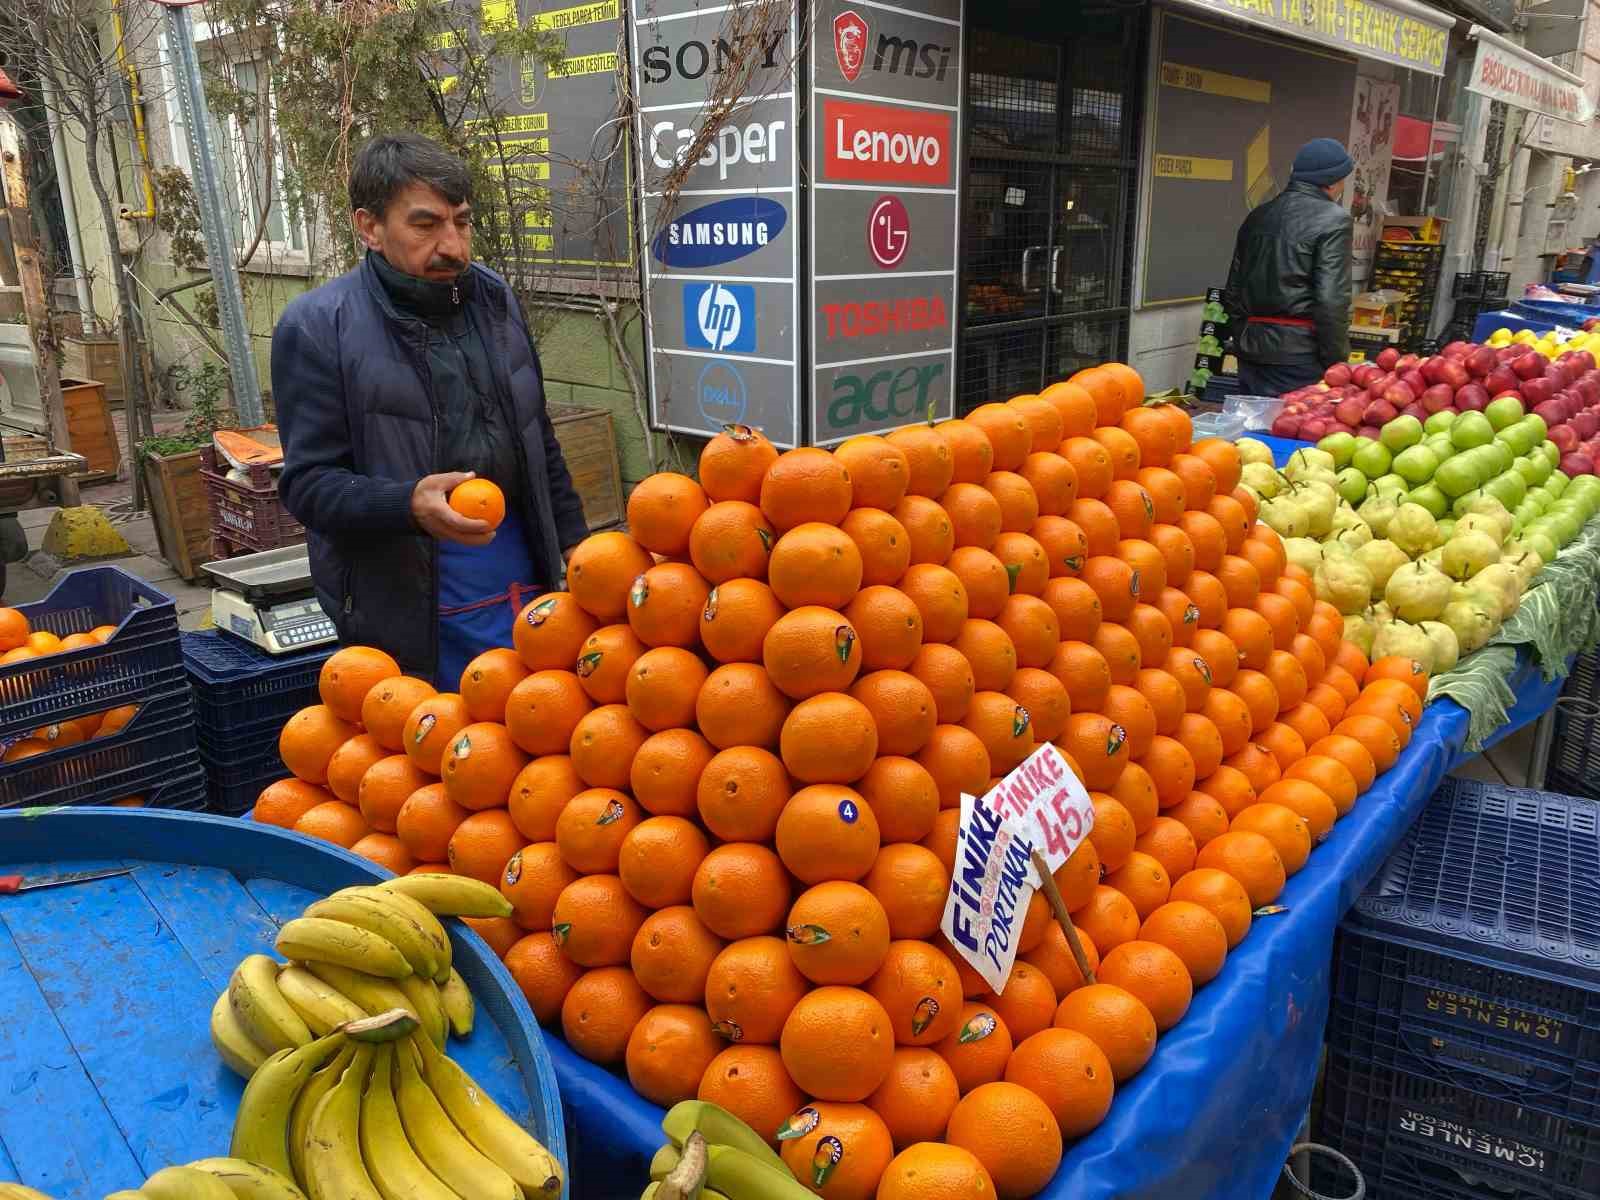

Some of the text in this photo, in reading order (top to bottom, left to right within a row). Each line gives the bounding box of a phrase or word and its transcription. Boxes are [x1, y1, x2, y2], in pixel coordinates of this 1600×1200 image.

[643, 28, 788, 84] SONY
[873, 33, 952, 82] msi
[650, 120, 786, 180] Casper
[837, 118, 940, 166] Lenovo
[669, 222, 769, 246] SAMSUNG
[703, 283, 737, 350] hp
[821, 295, 948, 338] TOSHIBA
[827, 362, 946, 429] acer
[1035, 786, 1083, 859] 45
[984, 833, 1033, 973] PORTAKAL
